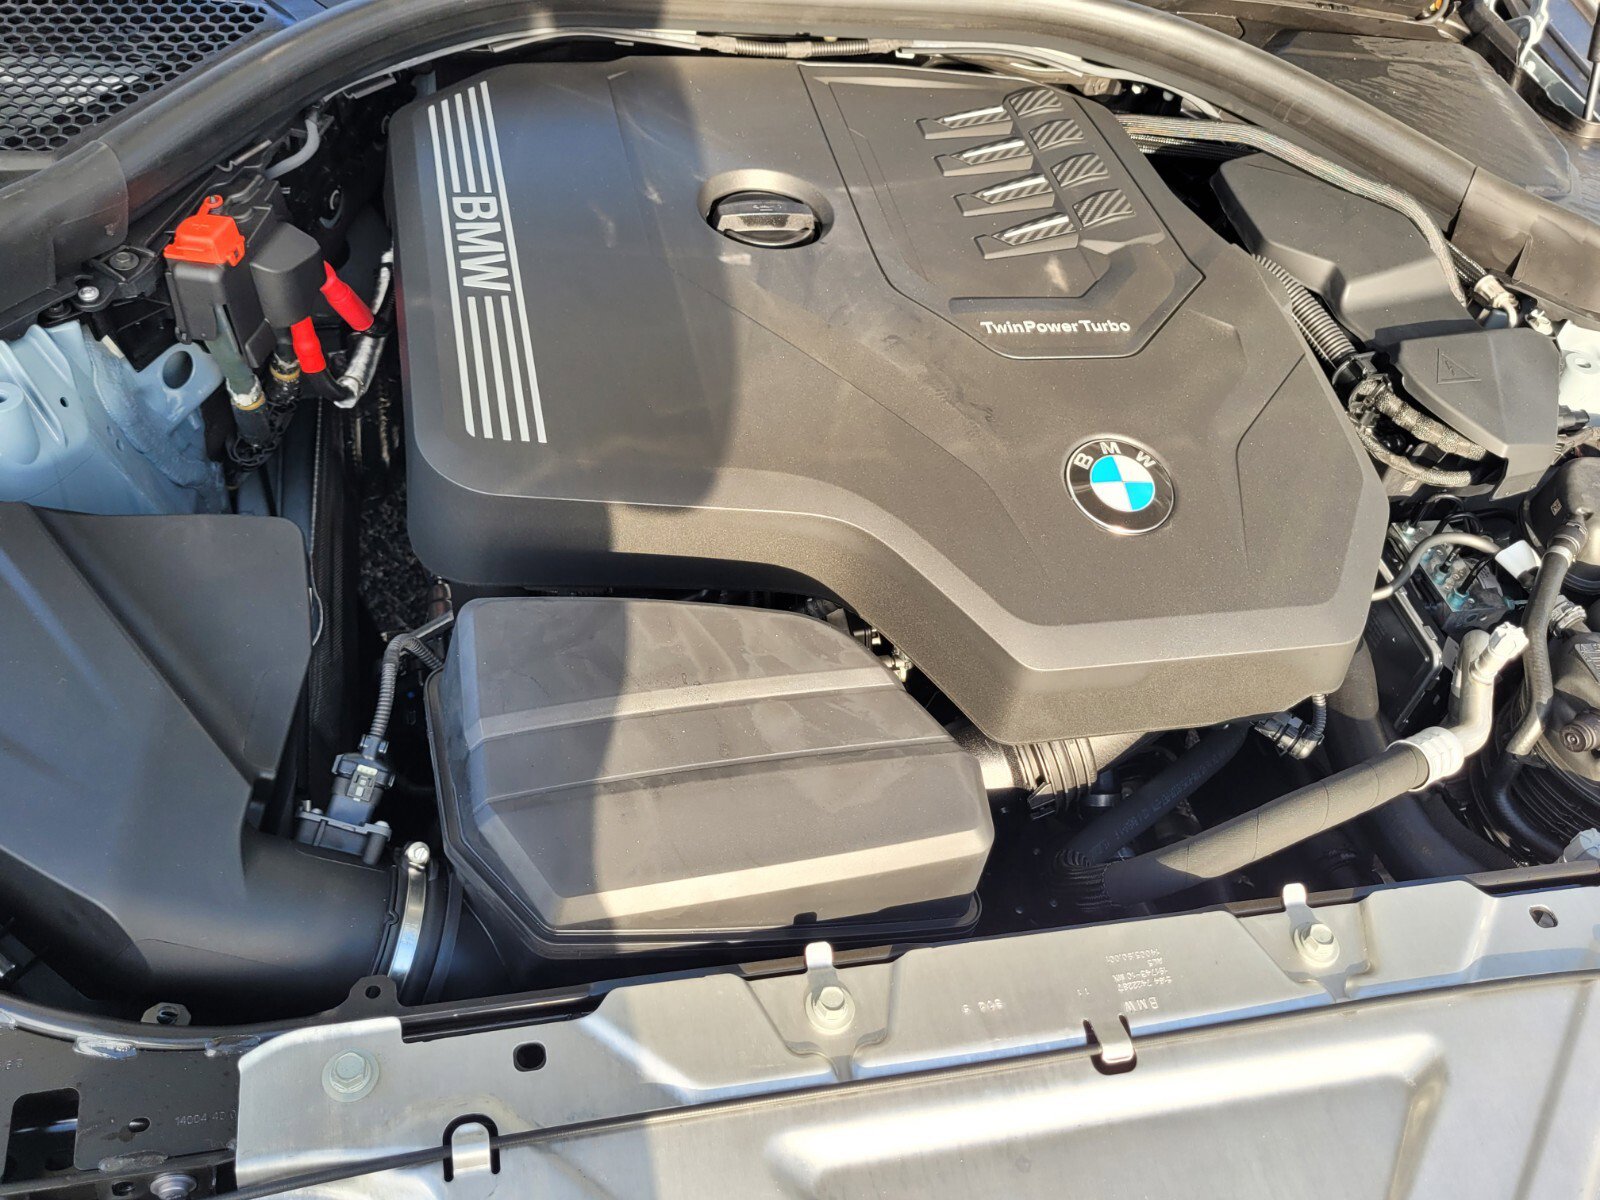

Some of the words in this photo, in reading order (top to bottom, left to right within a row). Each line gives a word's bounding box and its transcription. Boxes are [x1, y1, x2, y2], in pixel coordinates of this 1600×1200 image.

[452, 196, 511, 291] BMW
[1074, 441, 1156, 470] BMW
[1124, 996, 1159, 1012] BMW
